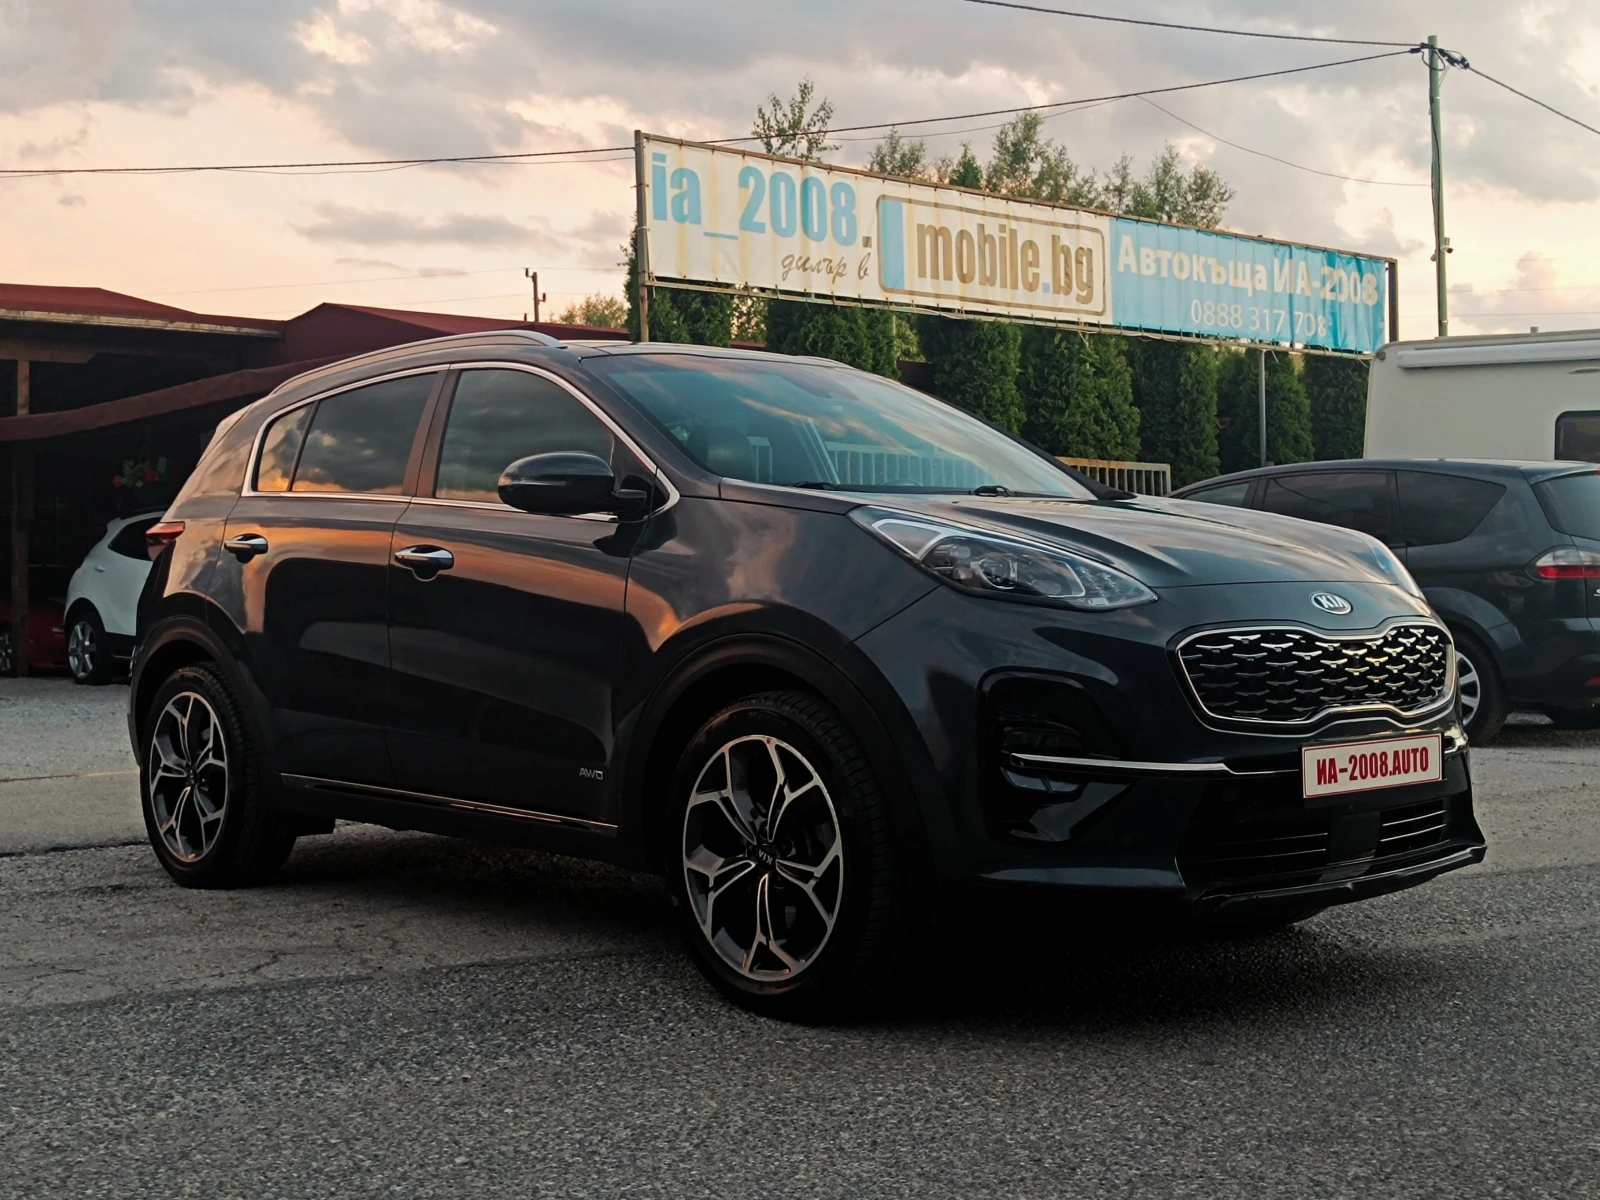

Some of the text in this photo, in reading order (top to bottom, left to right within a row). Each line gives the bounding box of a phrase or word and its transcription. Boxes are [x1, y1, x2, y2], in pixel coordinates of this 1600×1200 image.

[781, 252, 871, 284] дилър в
[916, 222, 1094, 305] mobile.bg
[1117, 235, 1379, 306] Автокъща ИА-2008
[1190, 299, 1327, 338] 0888 317 708
[1315, 595, 1349, 609] KIA
[579, 767, 604, 780] AWD
